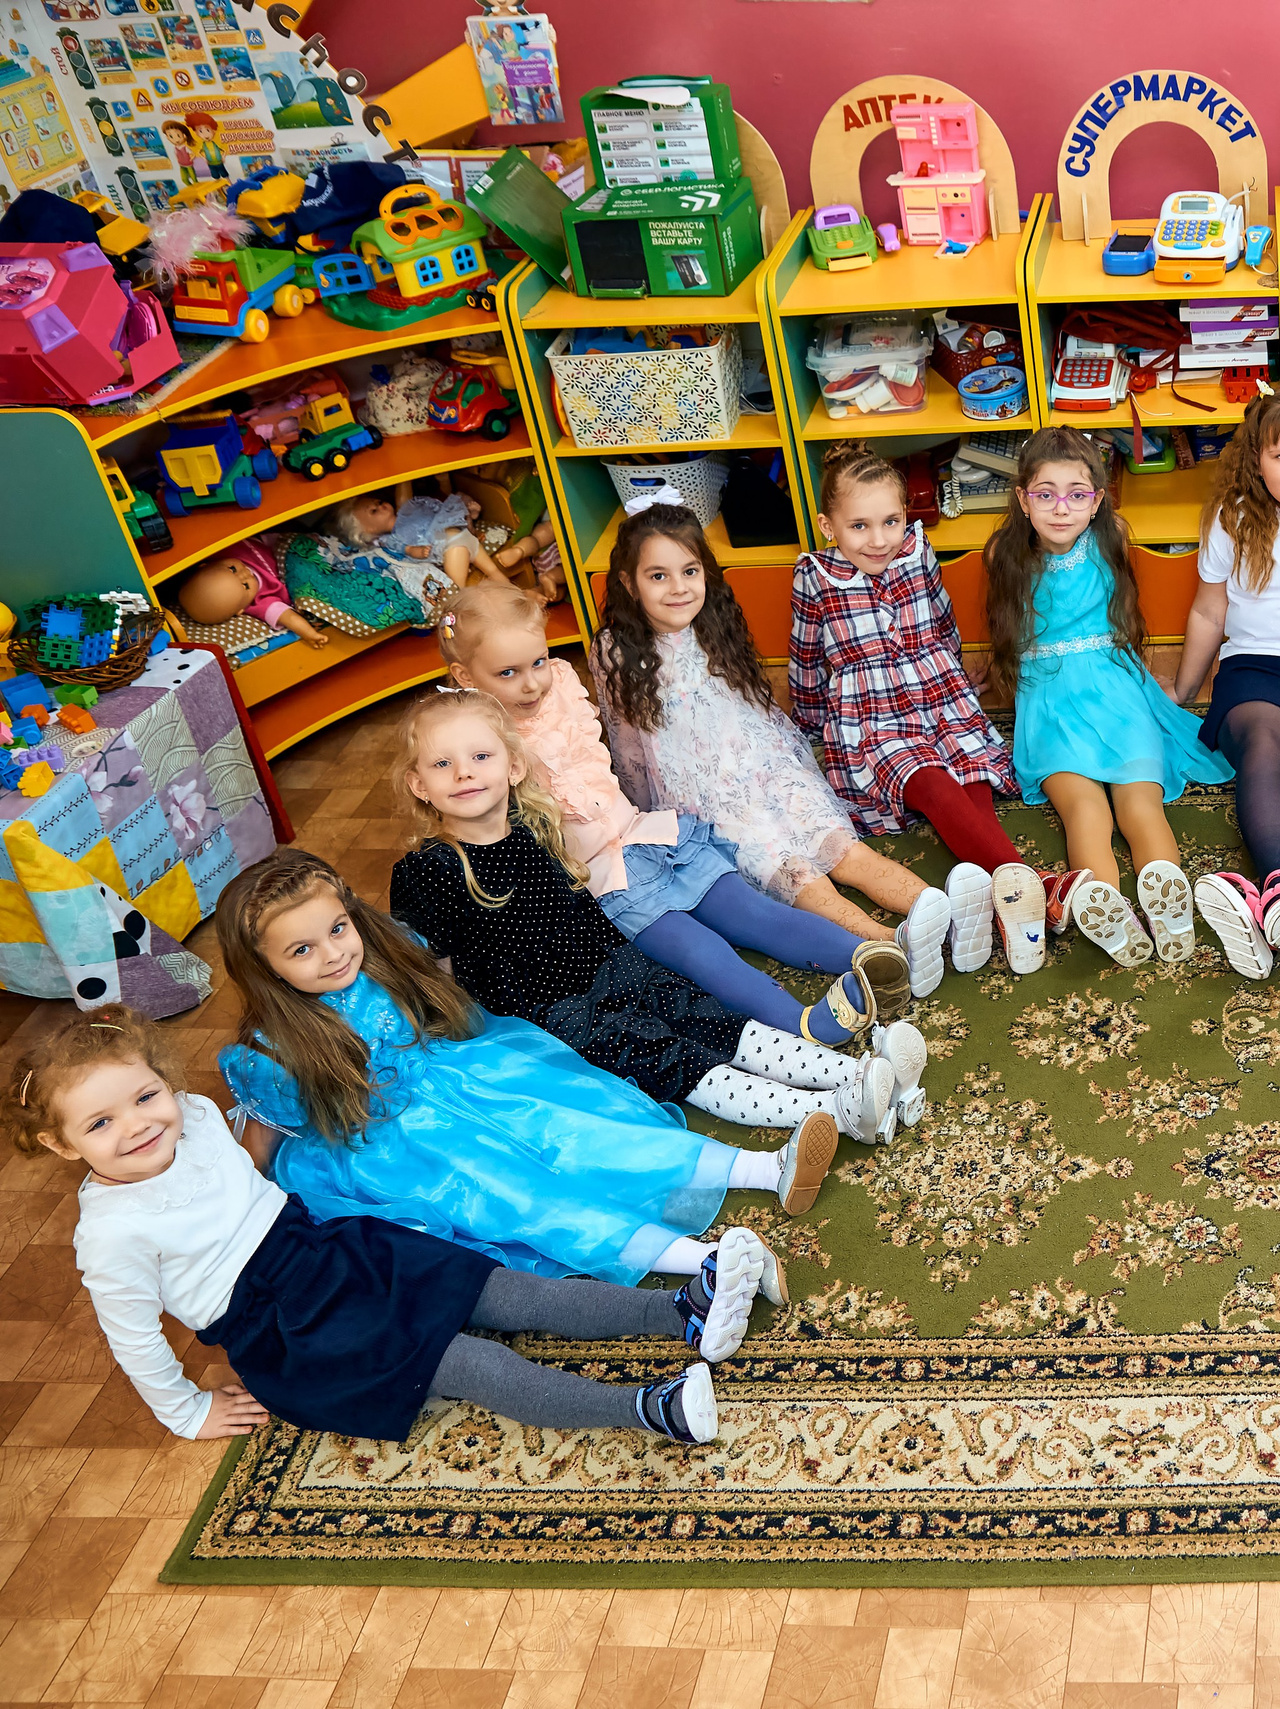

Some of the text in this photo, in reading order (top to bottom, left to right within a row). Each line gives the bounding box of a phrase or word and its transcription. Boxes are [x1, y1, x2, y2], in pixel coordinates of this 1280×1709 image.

[161, 97, 255, 114] МЫ СОБЛЮДАЕМ
[594, 110, 623, 118] ГЛАВНОЕ
[843, 94, 944, 132] АПТ
[1065, 74, 1257, 178] СУПЕРМАРКЕТ
[650, 230, 693, 238] ВСТАВЬТЕ
[652, 238, 703, 246] ВАШУ КАРТУ
